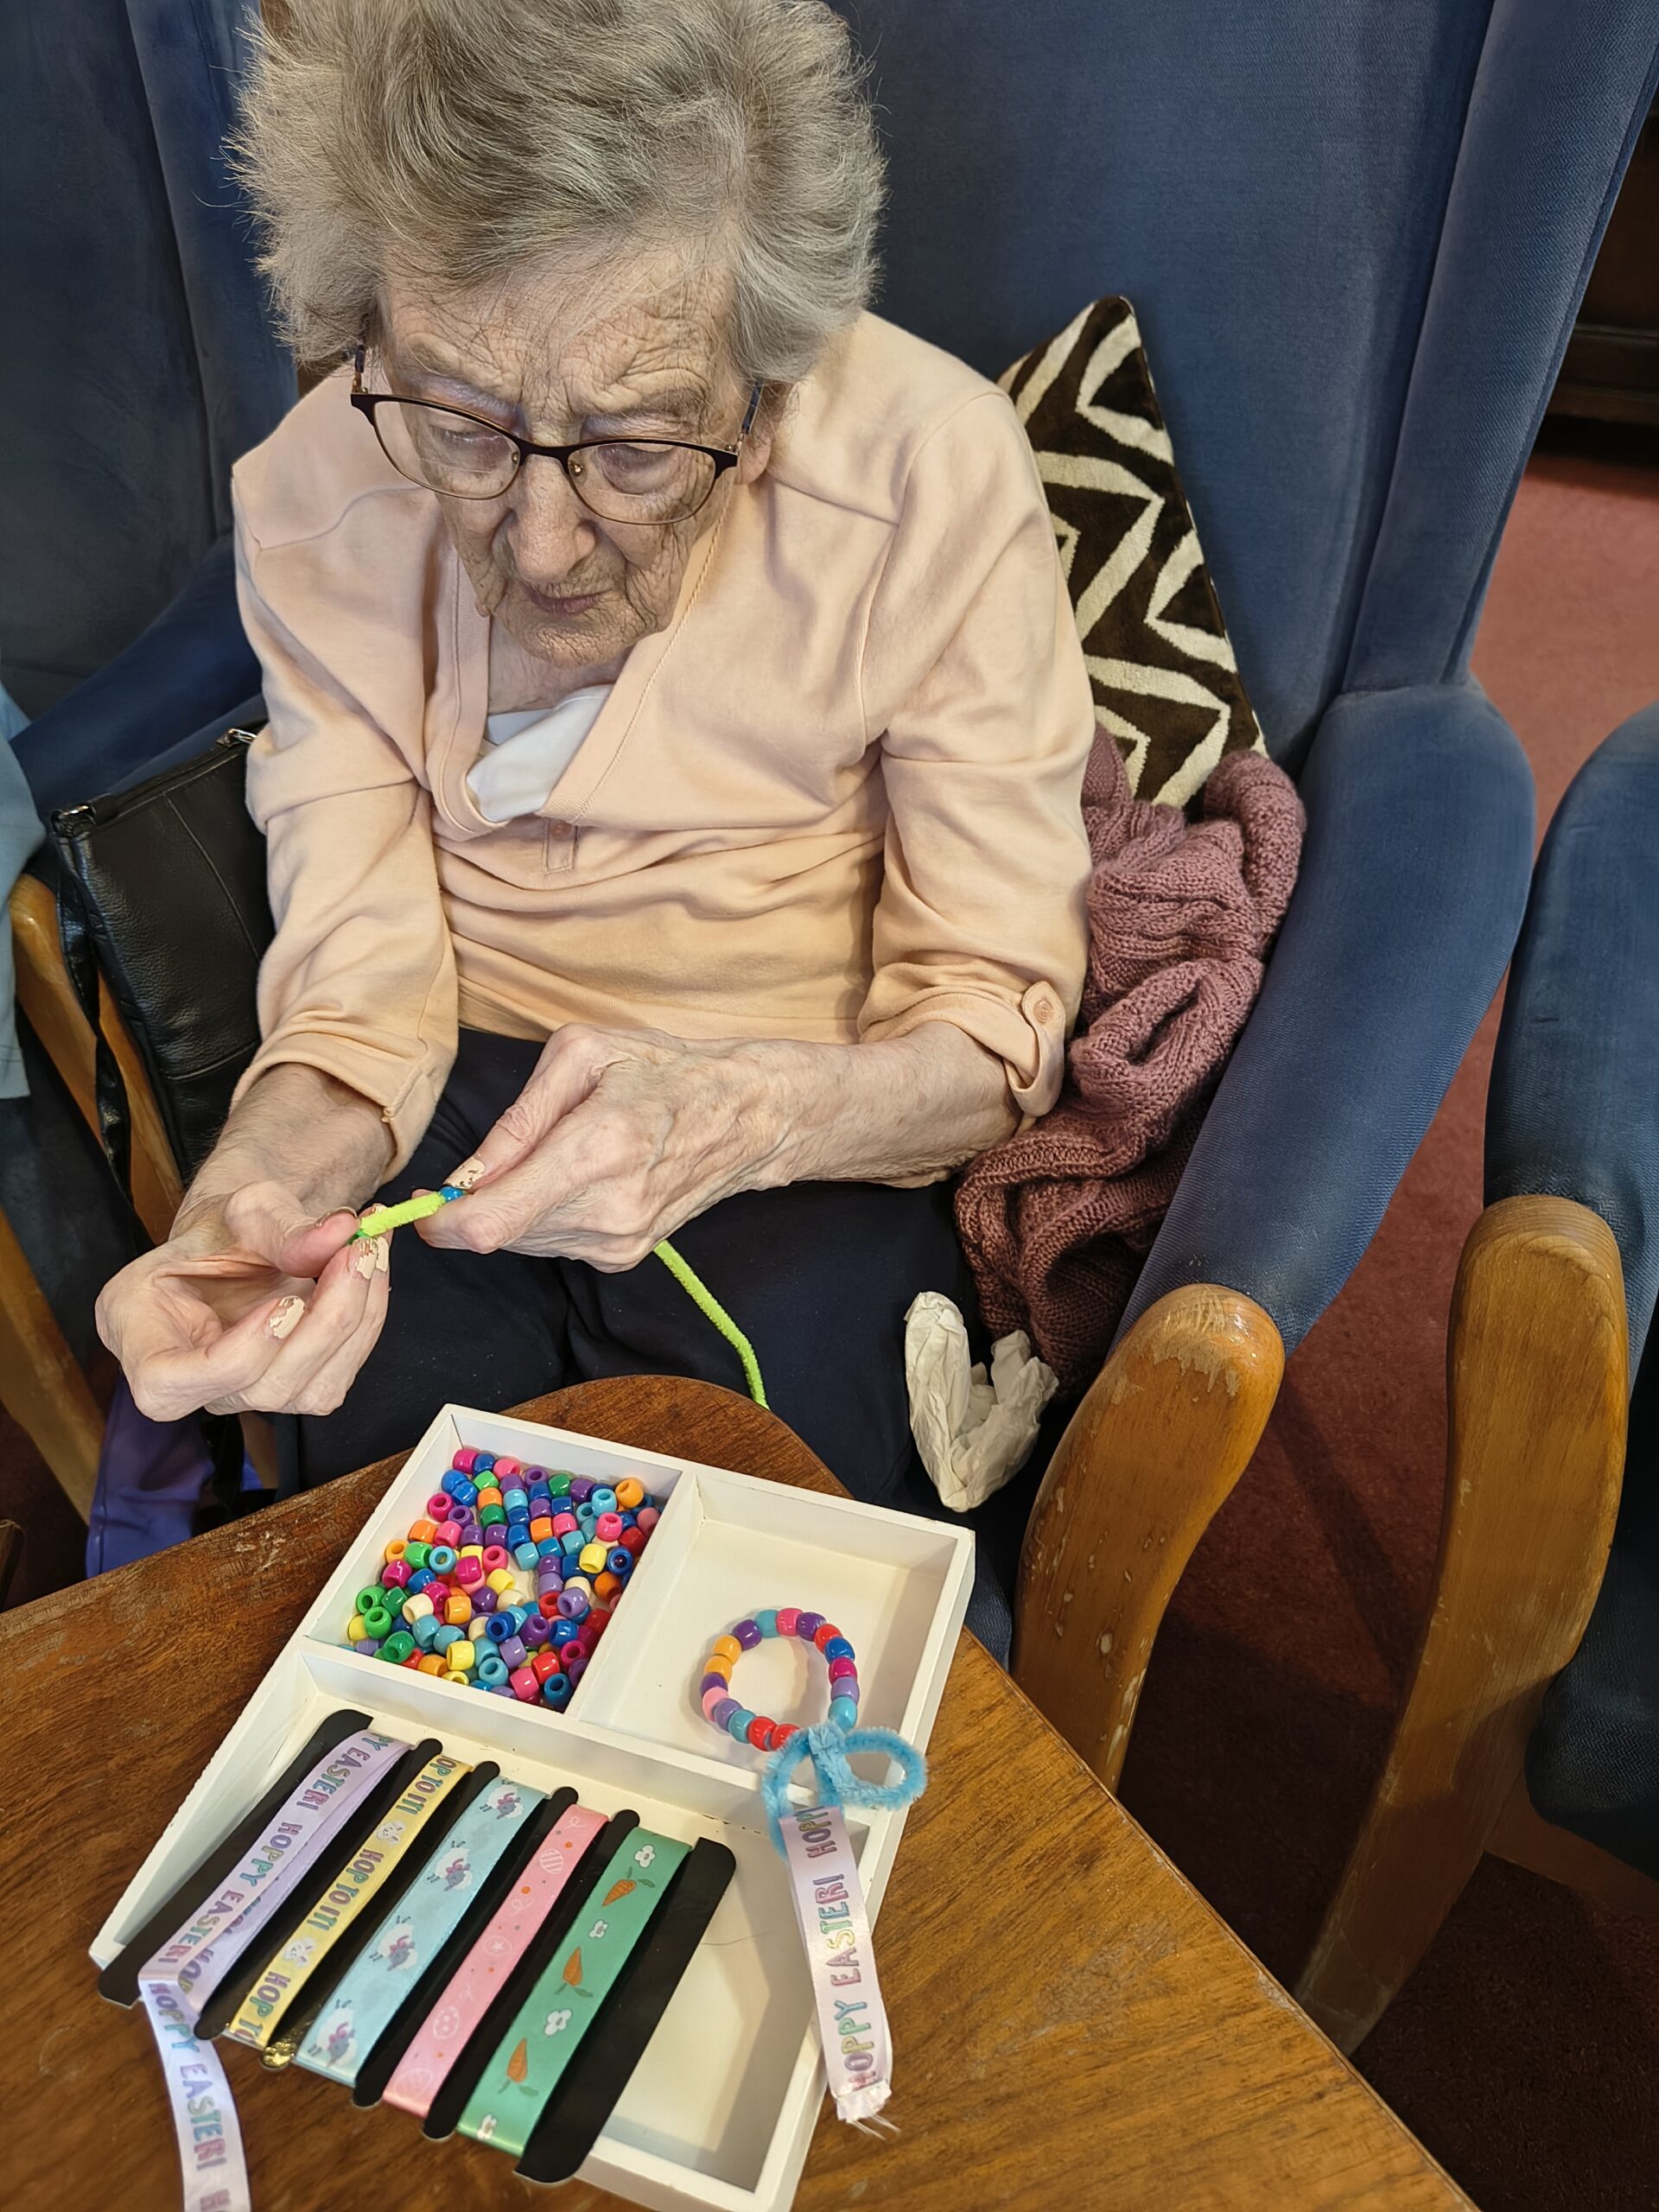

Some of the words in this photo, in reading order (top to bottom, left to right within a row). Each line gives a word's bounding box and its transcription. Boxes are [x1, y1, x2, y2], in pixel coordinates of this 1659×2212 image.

[296, 1747, 371, 1811] EASTER!
[415, 1775, 443, 1794] TO
[396, 1793, 427, 1815] IT!
[239, 1821, 302, 1887] HOPPY
[346, 1848, 385, 1885] HOP
[328, 1883, 359, 1905] TO
[158, 1889, 245, 1963] EASTER!
[307, 1905, 340, 1931] IT!
[812, 1873, 862, 1986] EASTER!
[250, 1971, 291, 2018] HOP
[149, 1982, 200, 2053] HOPPY
[180, 2063, 227, 2171] EASTER!
